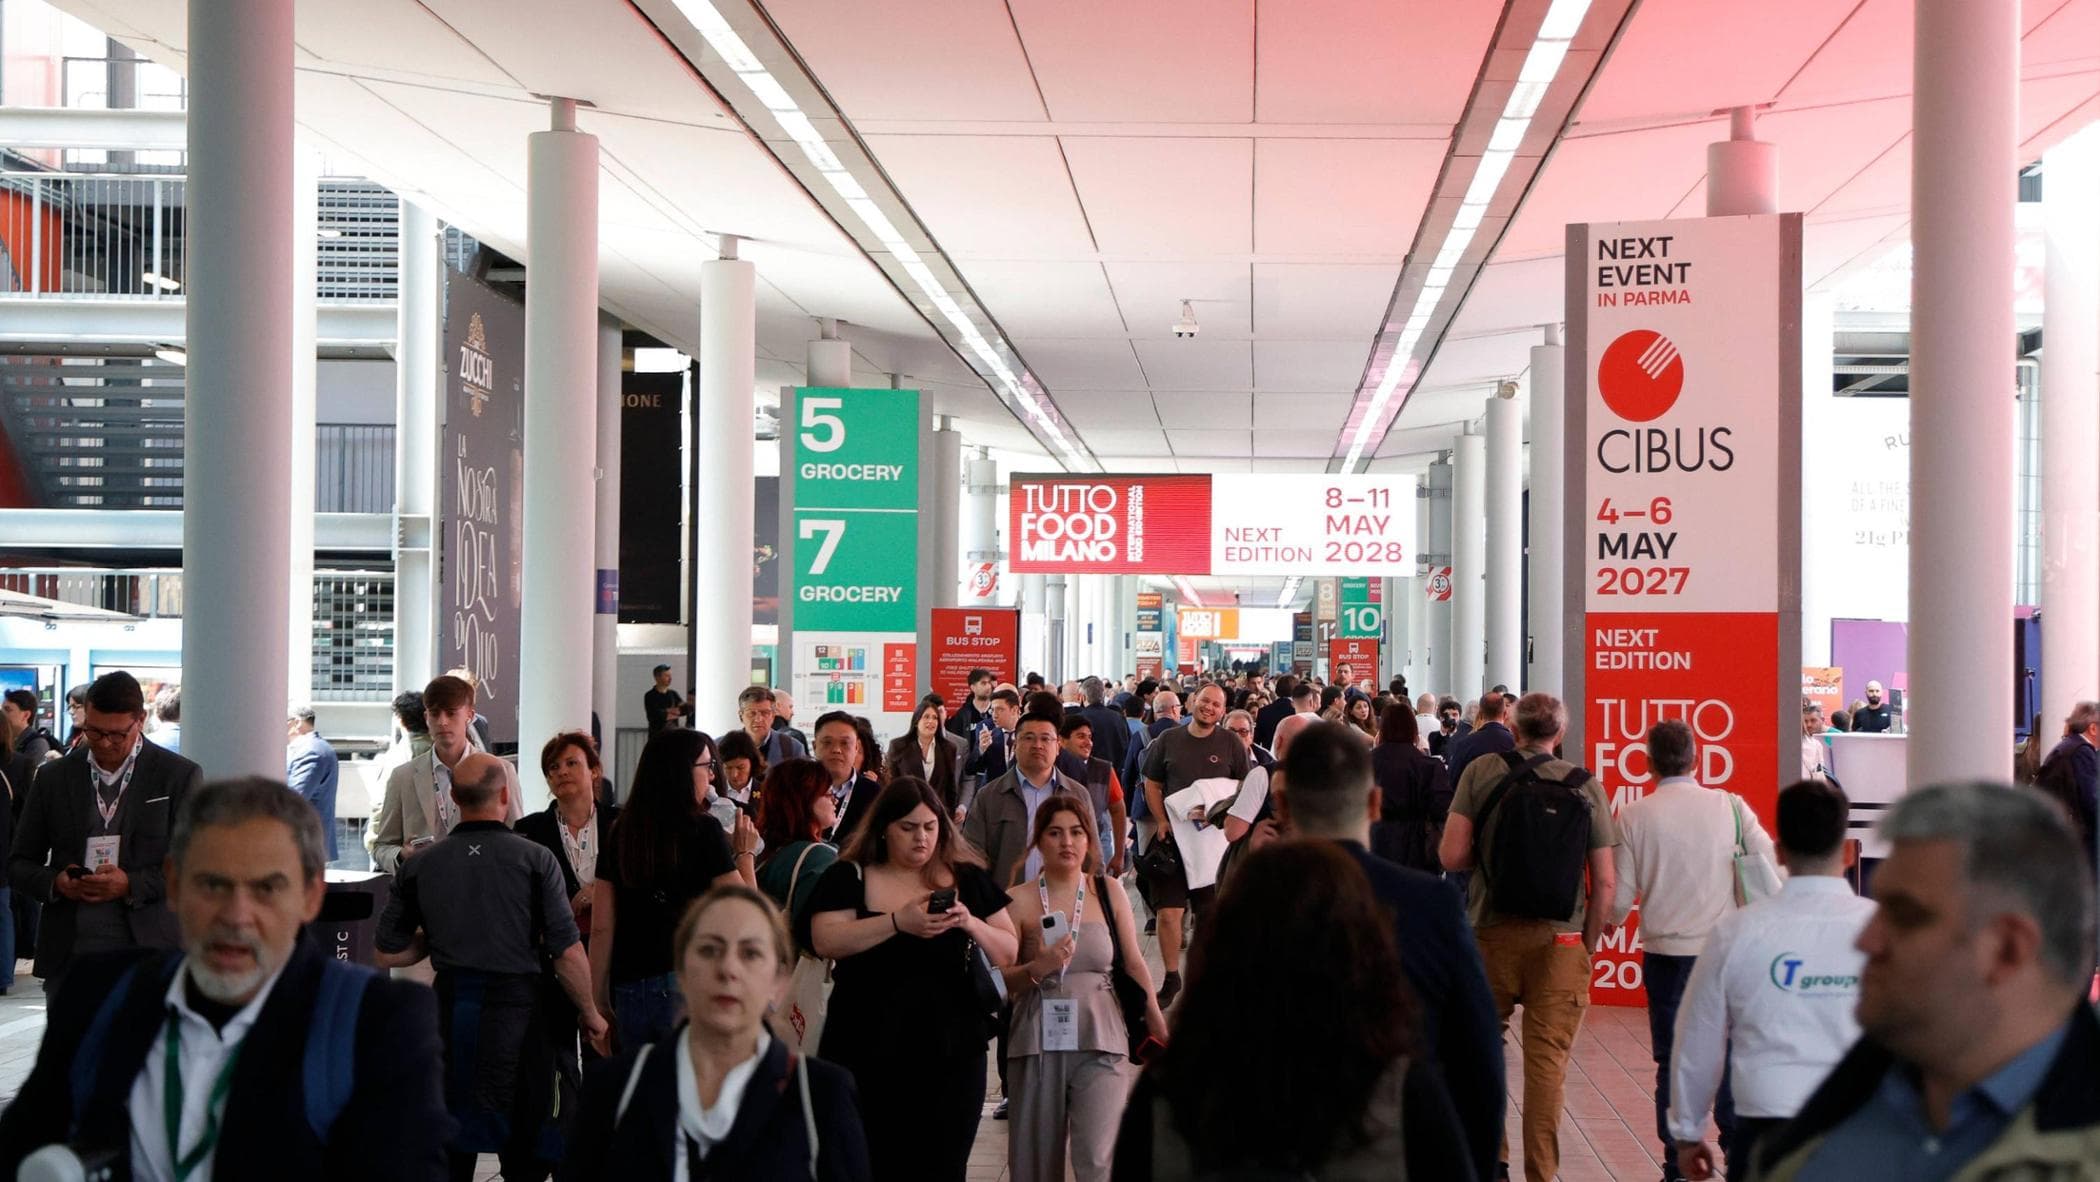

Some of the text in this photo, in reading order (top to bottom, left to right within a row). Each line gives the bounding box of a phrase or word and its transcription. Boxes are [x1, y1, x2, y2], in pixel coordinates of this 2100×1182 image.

[1598, 236, 1674, 261] NEXT
[1598, 262, 1692, 288] EVENT
[1598, 290, 1691, 307] IN PARMA
[460, 345, 493, 391] ZUCCHI
[800, 396, 846, 452] 5
[458, 433, 467, 458] LA
[1597, 426, 1734, 474] CIBUS
[801, 462, 904, 481] GROCERY
[1022, 484, 1117, 513] TUTTO
[1021, 512, 1117, 540] FOOD
[1224, 527, 1283, 543] NEXT
[1326, 514, 1391, 536] MAY
[799, 519, 846, 575] 7
[1020, 540, 1117, 562] MILANO
[1224, 546, 1313, 562] EDITION
[1325, 541, 1403, 563] 2028
[1598, 532, 1678, 560] MAY
[1596, 567, 1691, 595] 2027
[799, 585, 903, 603] GROCERY
[1343, 607, 1380, 632] 10
[946, 636, 1001, 647] BUS STOP
[1595, 628, 1659, 648] NEXT
[1595, 650, 1692, 670] EDITION
[1595, 698, 1734, 742] TUTTO
[1595, 742, 1734, 785] FOD
[337, 931, 349, 962] ST C
[1595, 925, 1644, 954] MA
[1593, 959, 1643, 990] 20
[1799, 975, 1858, 990] group
